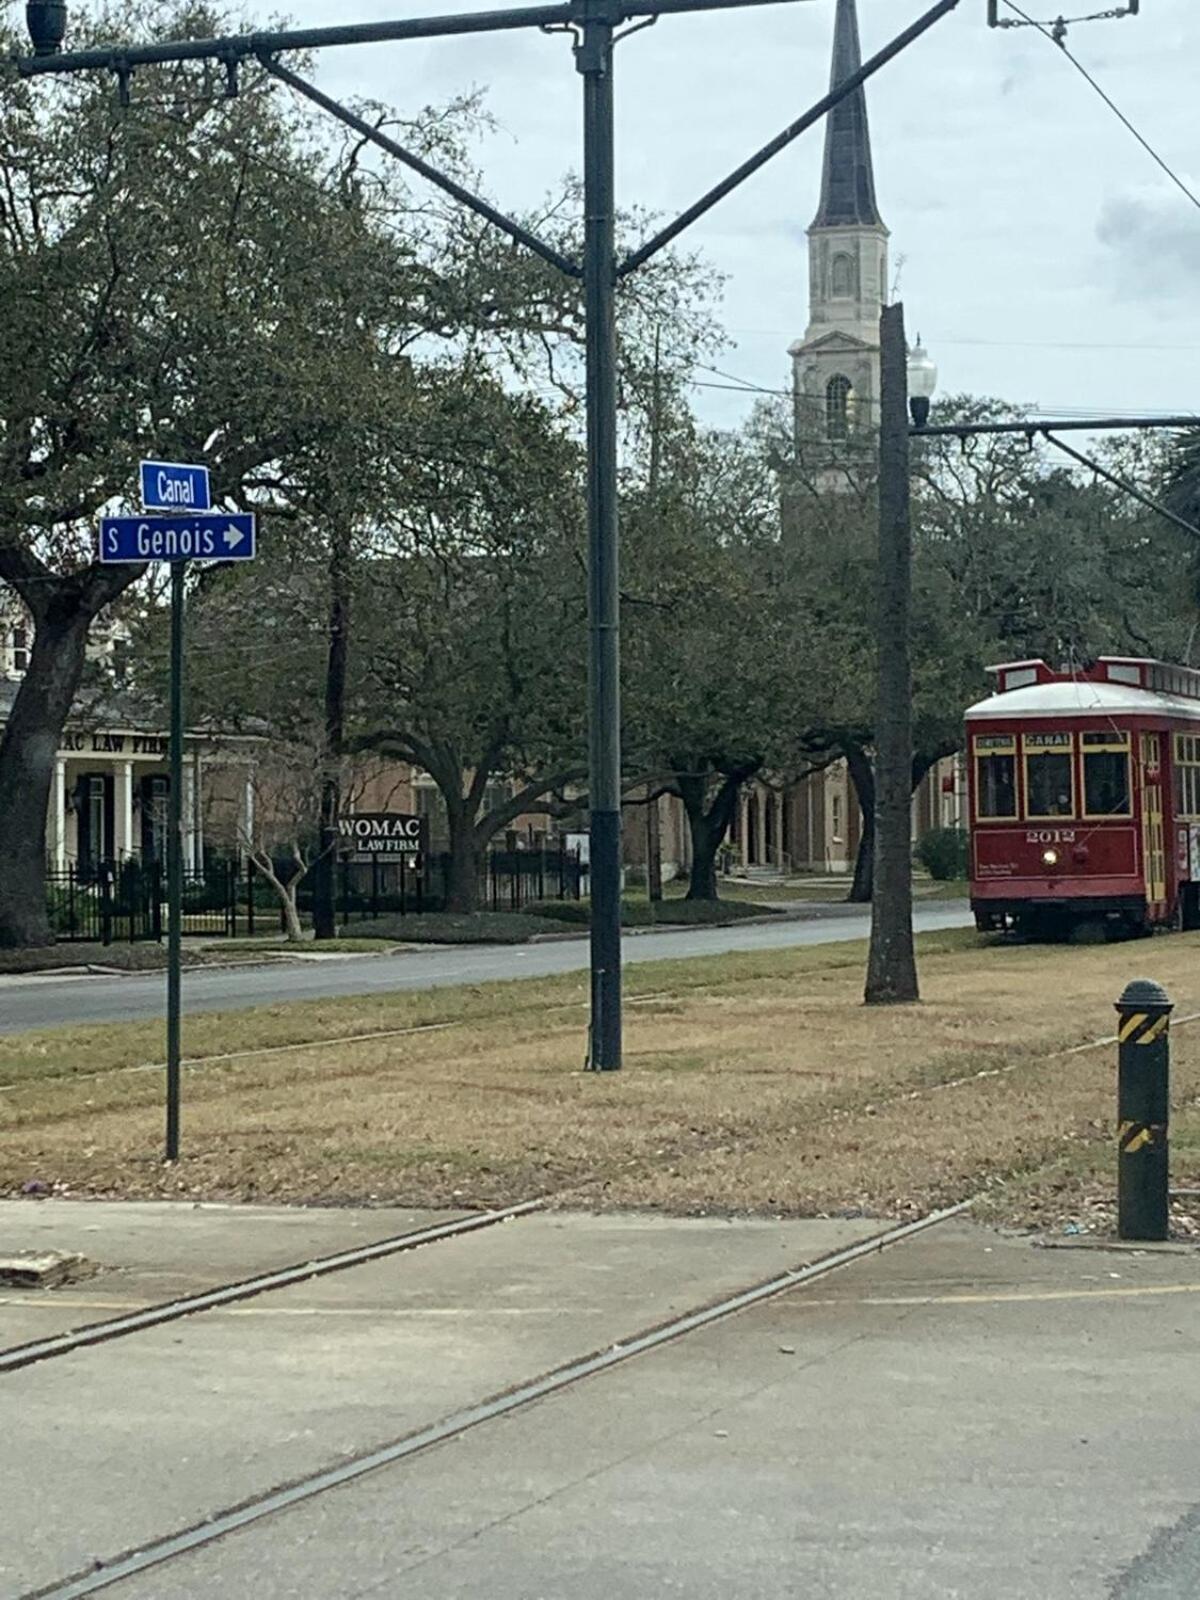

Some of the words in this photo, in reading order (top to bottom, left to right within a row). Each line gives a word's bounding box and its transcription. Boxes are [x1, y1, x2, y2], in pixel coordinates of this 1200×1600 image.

[157, 470, 195, 504] Canal
[108, 527, 119, 553] S
[137, 522, 215, 556] Genois
[92, 734, 124, 752] LAW
[338, 819, 420, 837] WOMAC
[1026, 829, 1075, 843] 2012
[358, 840, 384, 851] LAW
[386, 840, 419, 851] FIRM
